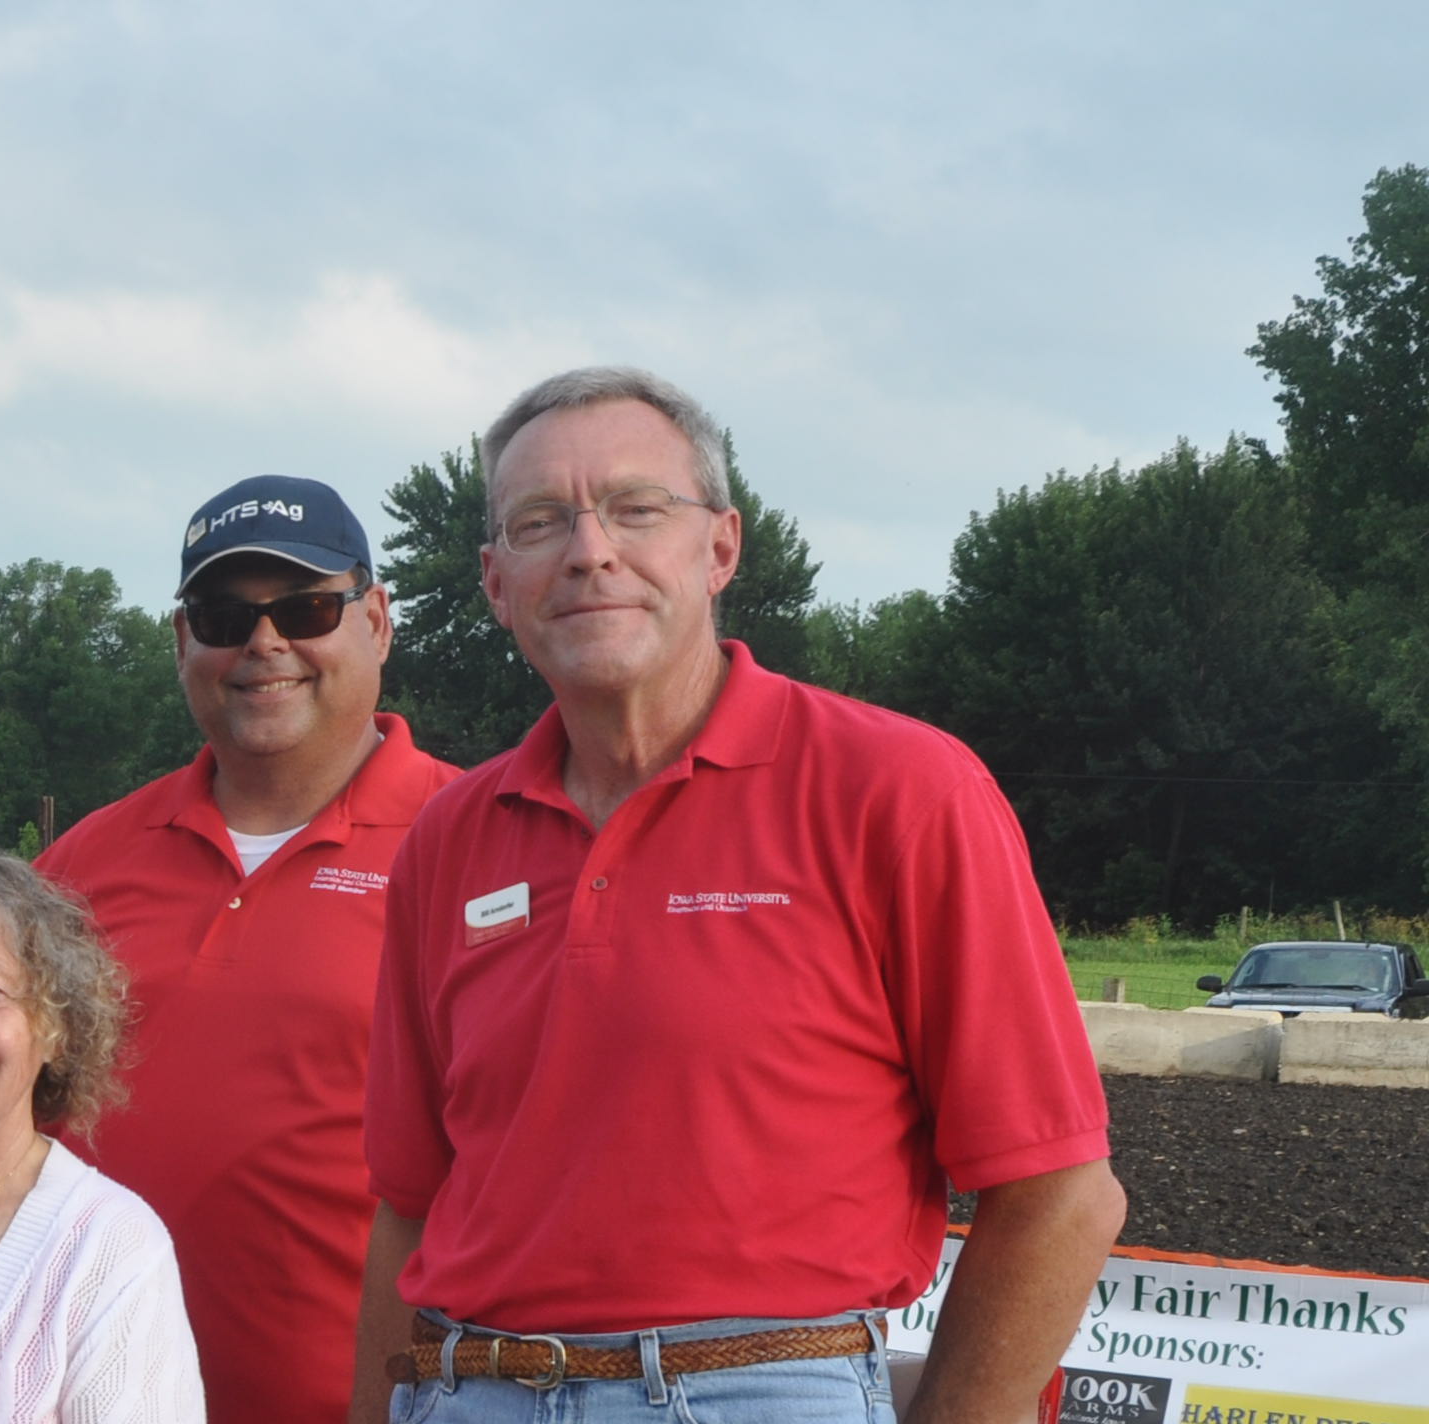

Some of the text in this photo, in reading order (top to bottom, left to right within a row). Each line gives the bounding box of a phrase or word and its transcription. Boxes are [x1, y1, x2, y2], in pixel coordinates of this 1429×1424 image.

[209, 499, 304, 532] HTS Ag
[695, 892, 727, 904] STATE
[728, 892, 789, 904] UNIVERSITY
[1130, 1273, 1221, 1319] Fair
[1229, 1281, 1408, 1337] Thanks
[1087, 1321, 1265, 1370] Sponsors:
[1060, 1399, 1141, 1418] ARMS
[1061, 1375, 1158, 1412] OOK
